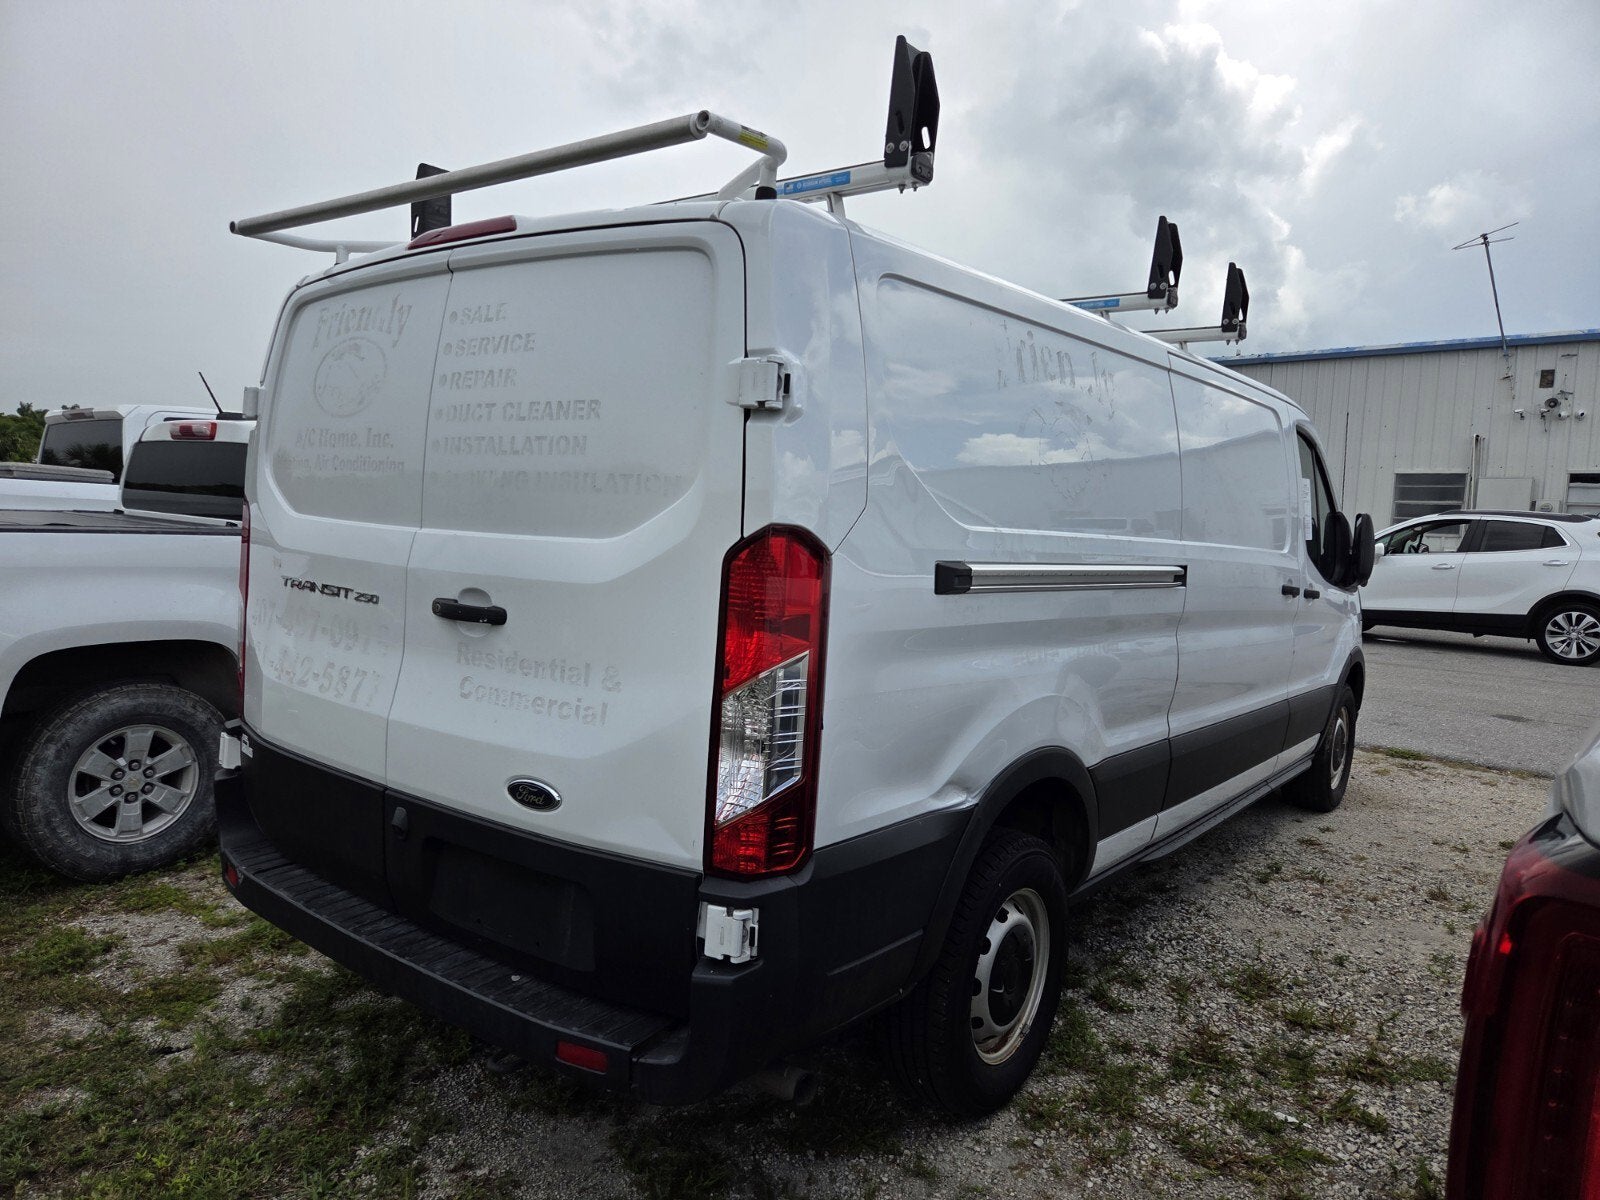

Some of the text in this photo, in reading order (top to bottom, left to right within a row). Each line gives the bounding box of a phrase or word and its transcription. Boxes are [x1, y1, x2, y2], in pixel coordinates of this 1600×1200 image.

[461, 302, 508, 326] SALE
[455, 332, 537, 357] SERVICE
[450, 368, 519, 390] REPAIR
[446, 399, 602, 423] DUCT CLEANER
[364, 426, 393, 448] Inc.
[442, 435, 588, 457] INSTALLATION
[315, 454, 330, 471] Air
[281, 575, 380, 604] TRANSIT 250
[456, 648, 622, 693] Residential &
[459, 676, 609, 726] Commercial
